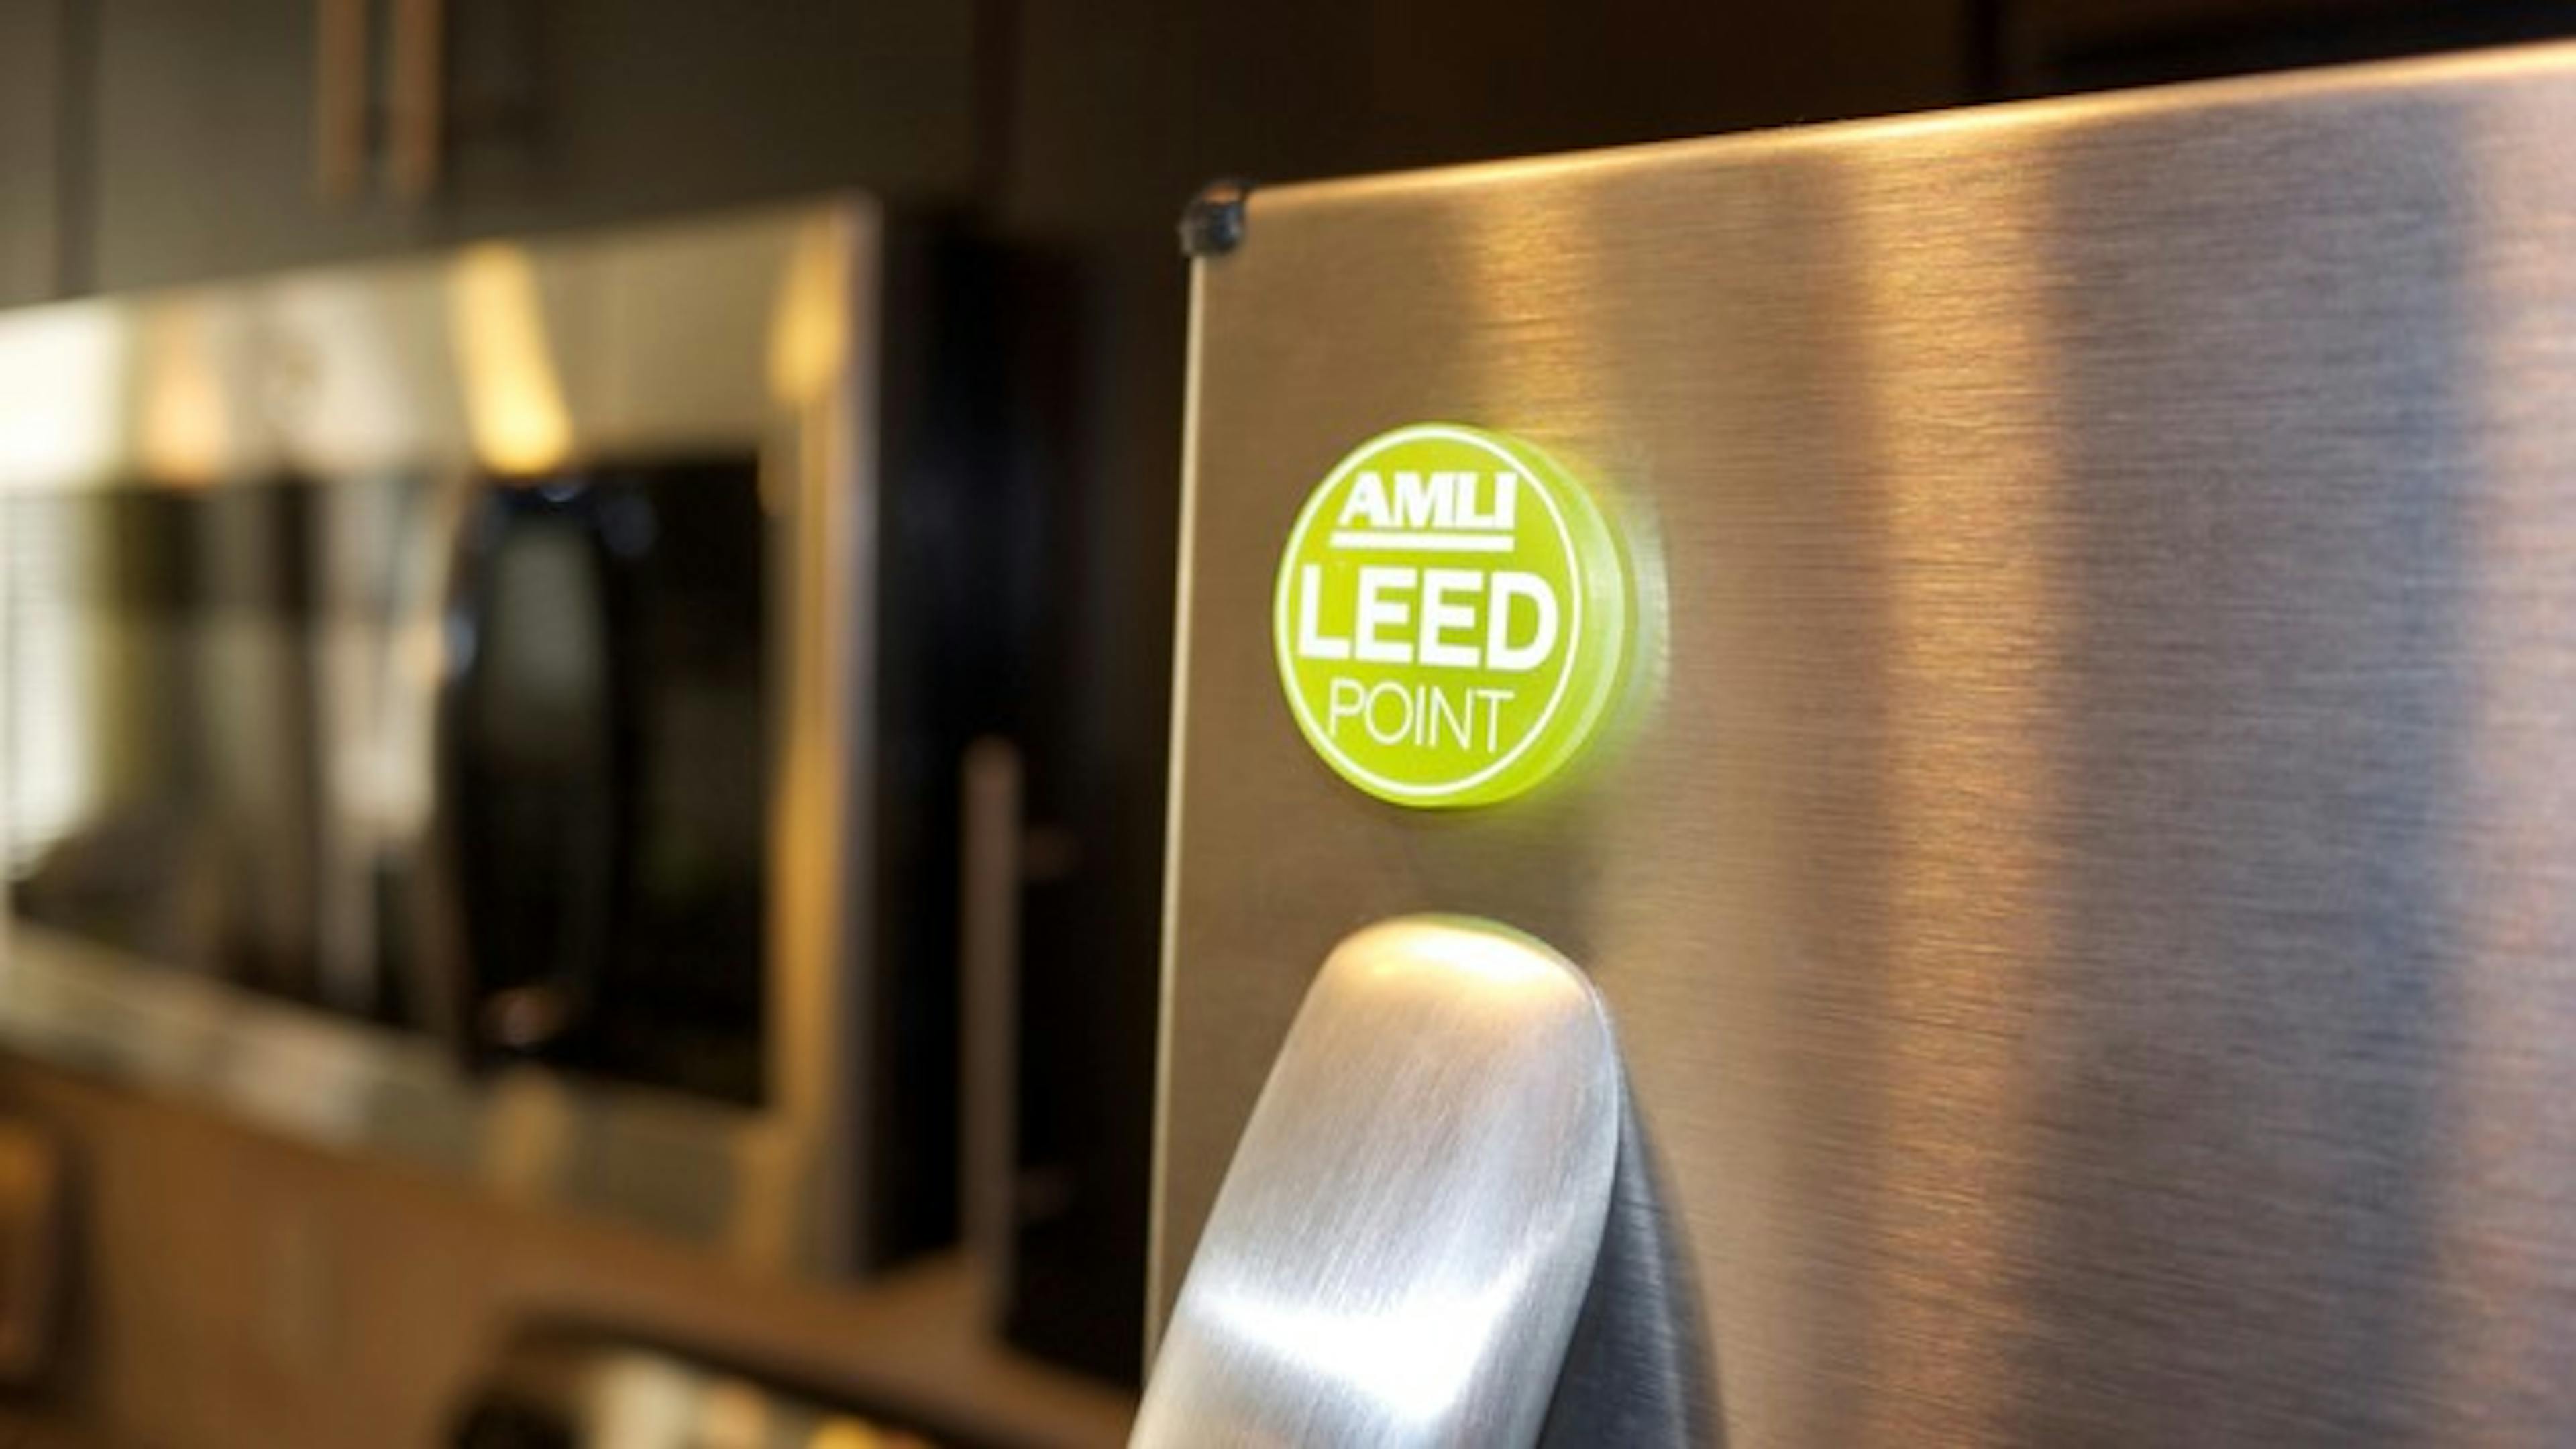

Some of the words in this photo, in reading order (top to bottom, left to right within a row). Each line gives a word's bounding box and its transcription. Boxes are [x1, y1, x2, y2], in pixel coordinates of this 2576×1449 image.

[1337, 471, 1517, 530] AMLI
[1299, 565, 1558, 671] LEED
[1330, 678, 1515, 753] POINT
